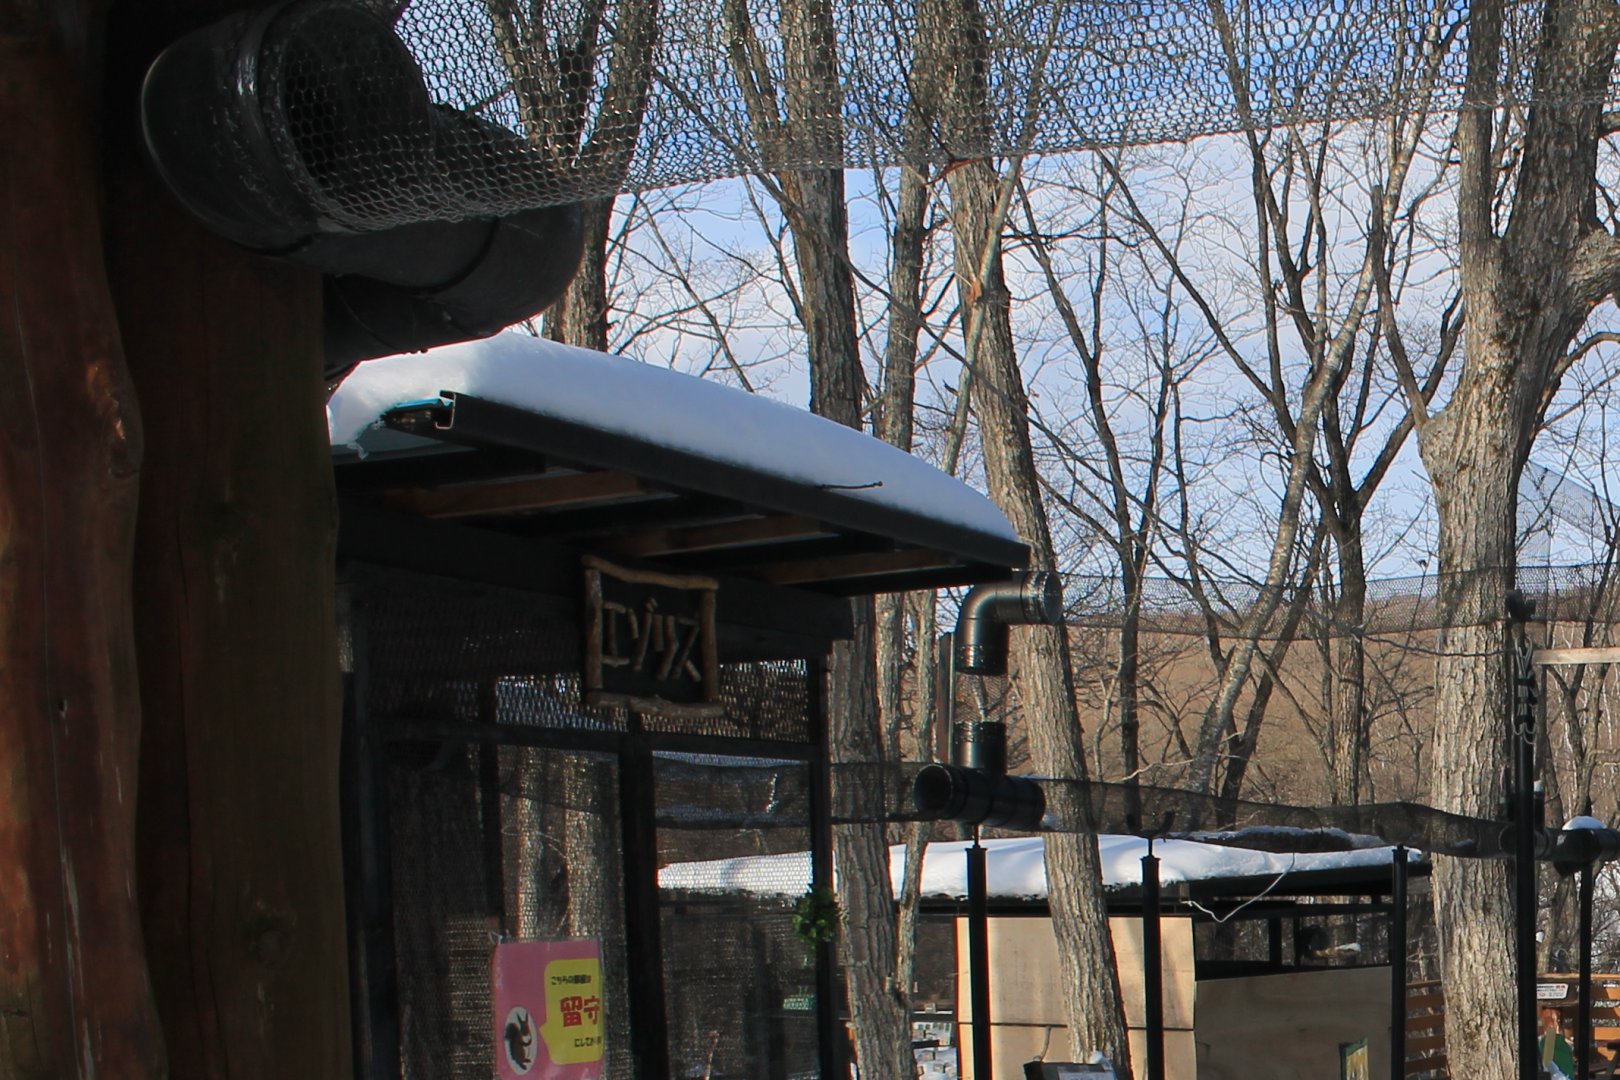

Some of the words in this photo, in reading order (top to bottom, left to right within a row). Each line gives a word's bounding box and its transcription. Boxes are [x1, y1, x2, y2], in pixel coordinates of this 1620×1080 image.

[602, 597, 702, 682] エゾリス
[560, 995, 601, 1027] 留守
